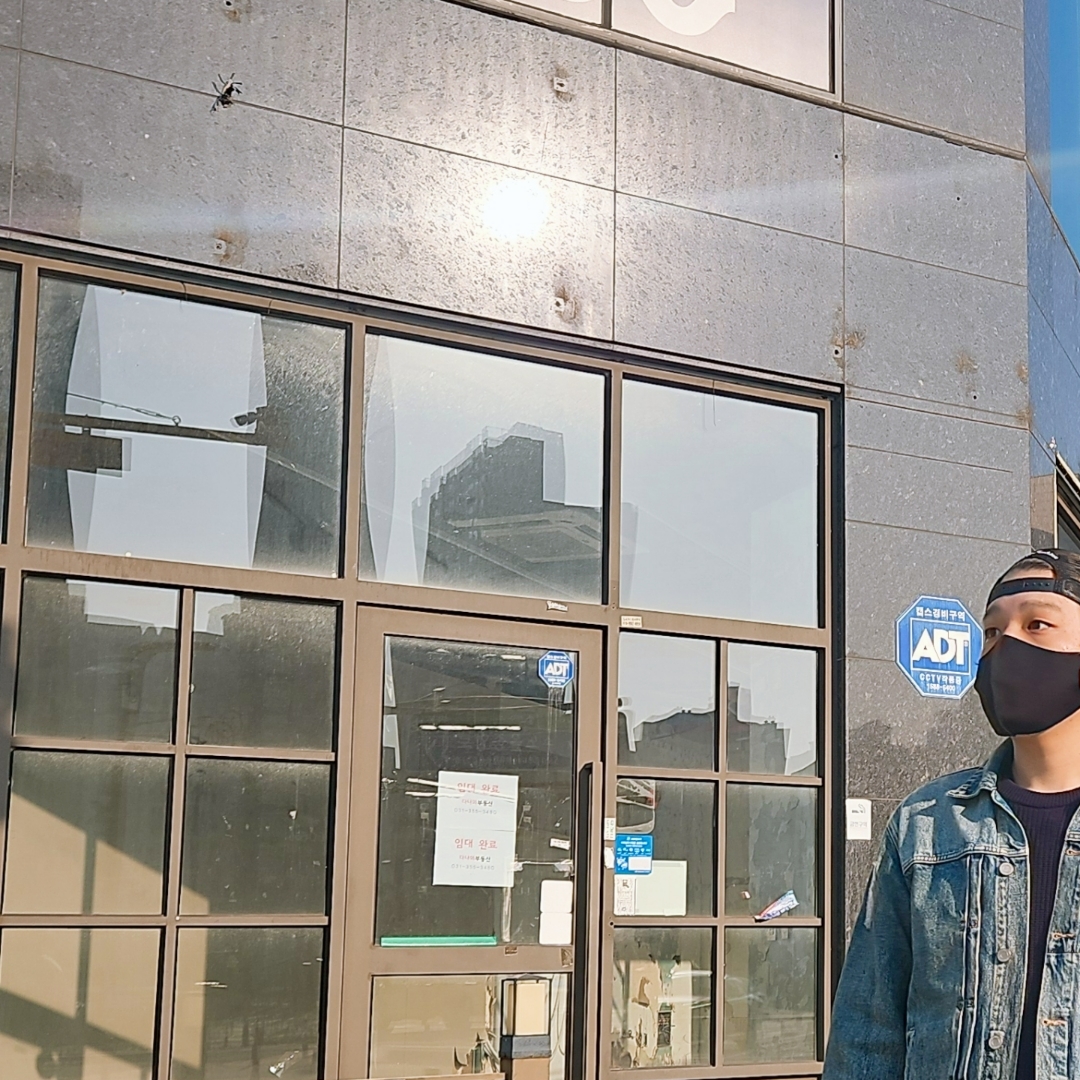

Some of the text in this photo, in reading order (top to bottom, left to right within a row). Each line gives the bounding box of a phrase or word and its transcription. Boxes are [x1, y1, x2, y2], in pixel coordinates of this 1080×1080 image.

[915, 606, 966, 622] 캡스경비구역
[911, 628, 969, 665] ADT
[544, 662, 569, 677] ADT
[457, 782, 476, 793] 임대
[454, 838, 498, 850] 임대 완료
